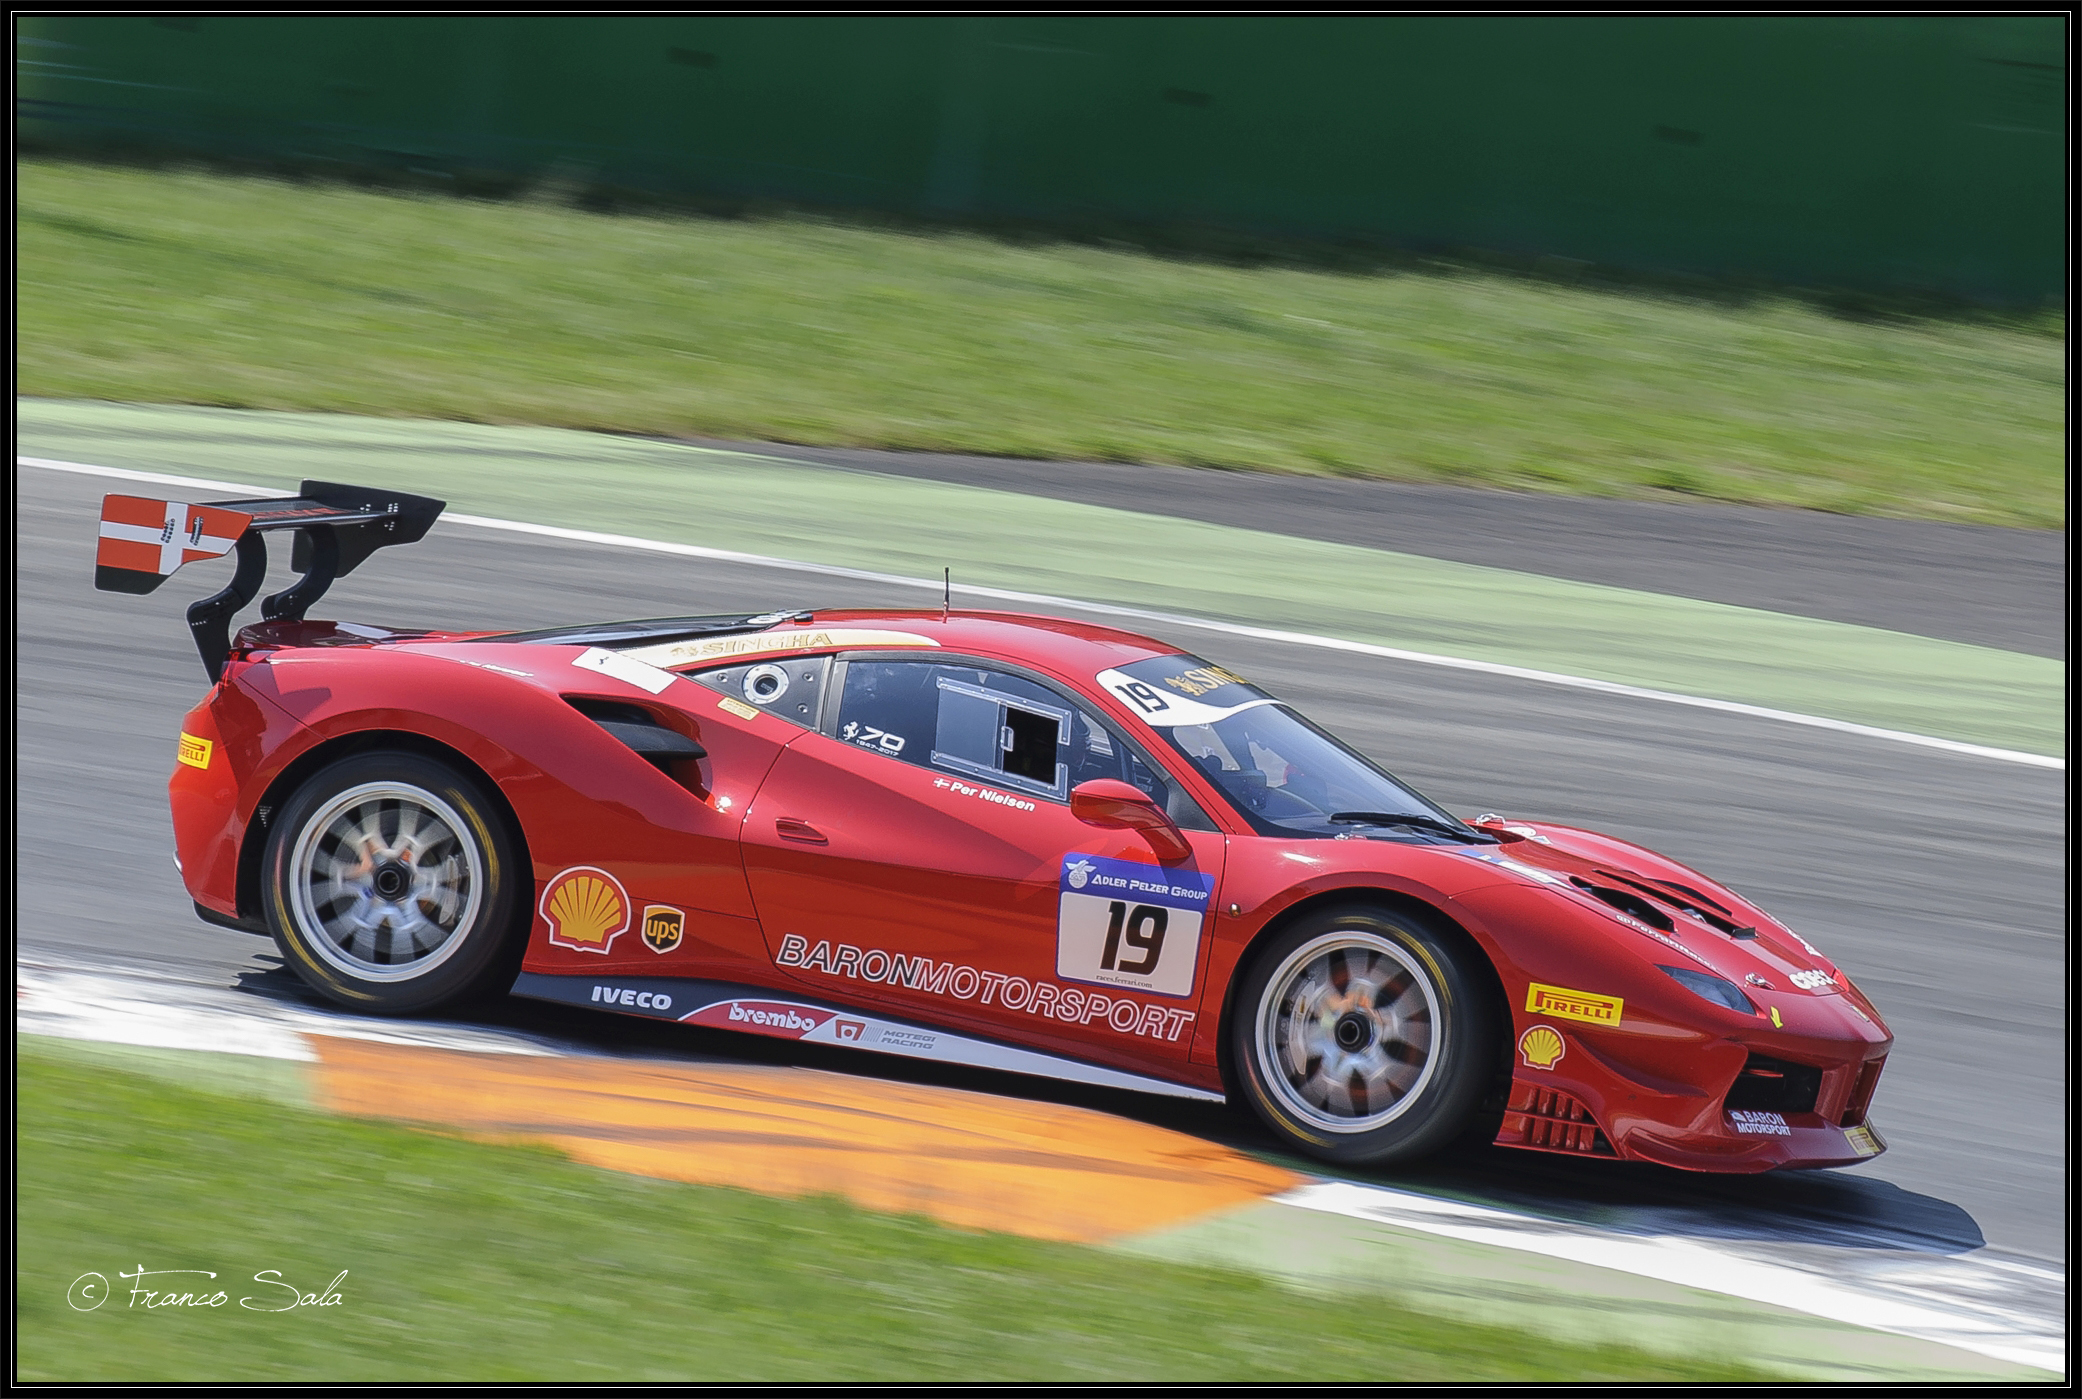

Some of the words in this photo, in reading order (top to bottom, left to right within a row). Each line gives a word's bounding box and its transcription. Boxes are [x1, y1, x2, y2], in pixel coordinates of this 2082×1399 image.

[700, 632, 833, 656] SINGHA
[1114, 682, 1170, 713] 19
[855, 739, 900, 756] 1947-2017
[858, 725, 905, 751] 70
[949, 781, 979, 797] Per
[978, 788, 1036, 812] Nielsen
[1091, 874, 1128, 888] ADLER
[1129, 879, 1169, 895] PELZER
[1170, 886, 1208, 901] GROUP
[646, 919, 679, 945] ups
[1100, 900, 1169, 976] 19
[591, 986, 672, 1011] IVECO
[1535, 990, 1614, 1019] PIRELLI
[728, 1002, 816, 1032] brembo
[880, 1037, 934, 1050] RACING
[883, 1030, 937, 1042] MOTEGI
[1736, 1122, 1791, 1136] MOTORSPORT
[1743, 1110, 1787, 1126] BARON
